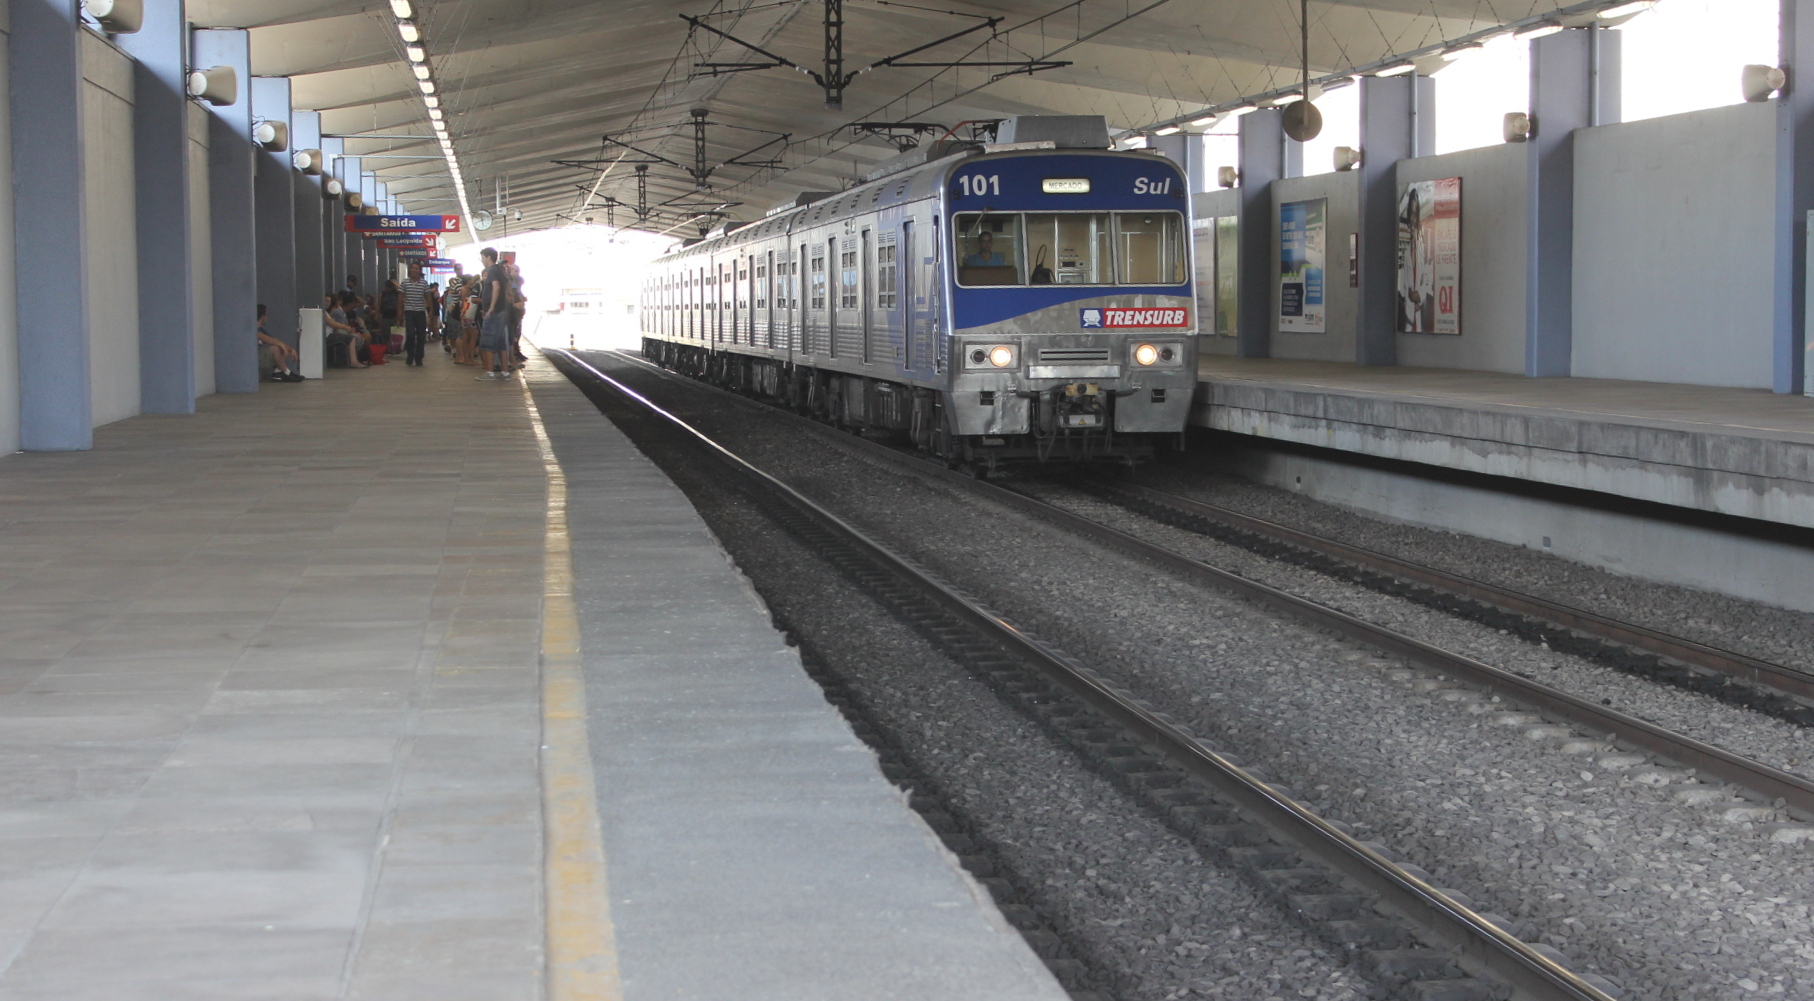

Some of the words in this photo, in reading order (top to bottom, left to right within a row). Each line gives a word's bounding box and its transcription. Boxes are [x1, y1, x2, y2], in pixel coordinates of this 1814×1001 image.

[959, 174, 1000, 196] 101
[1048, 182, 1083, 190] MERCADO
[1133, 176, 1171, 195] Sul
[380, 217, 417, 228] Saída
[1438, 285, 1454, 315] QI
[1105, 310, 1185, 325] TRENSURB
